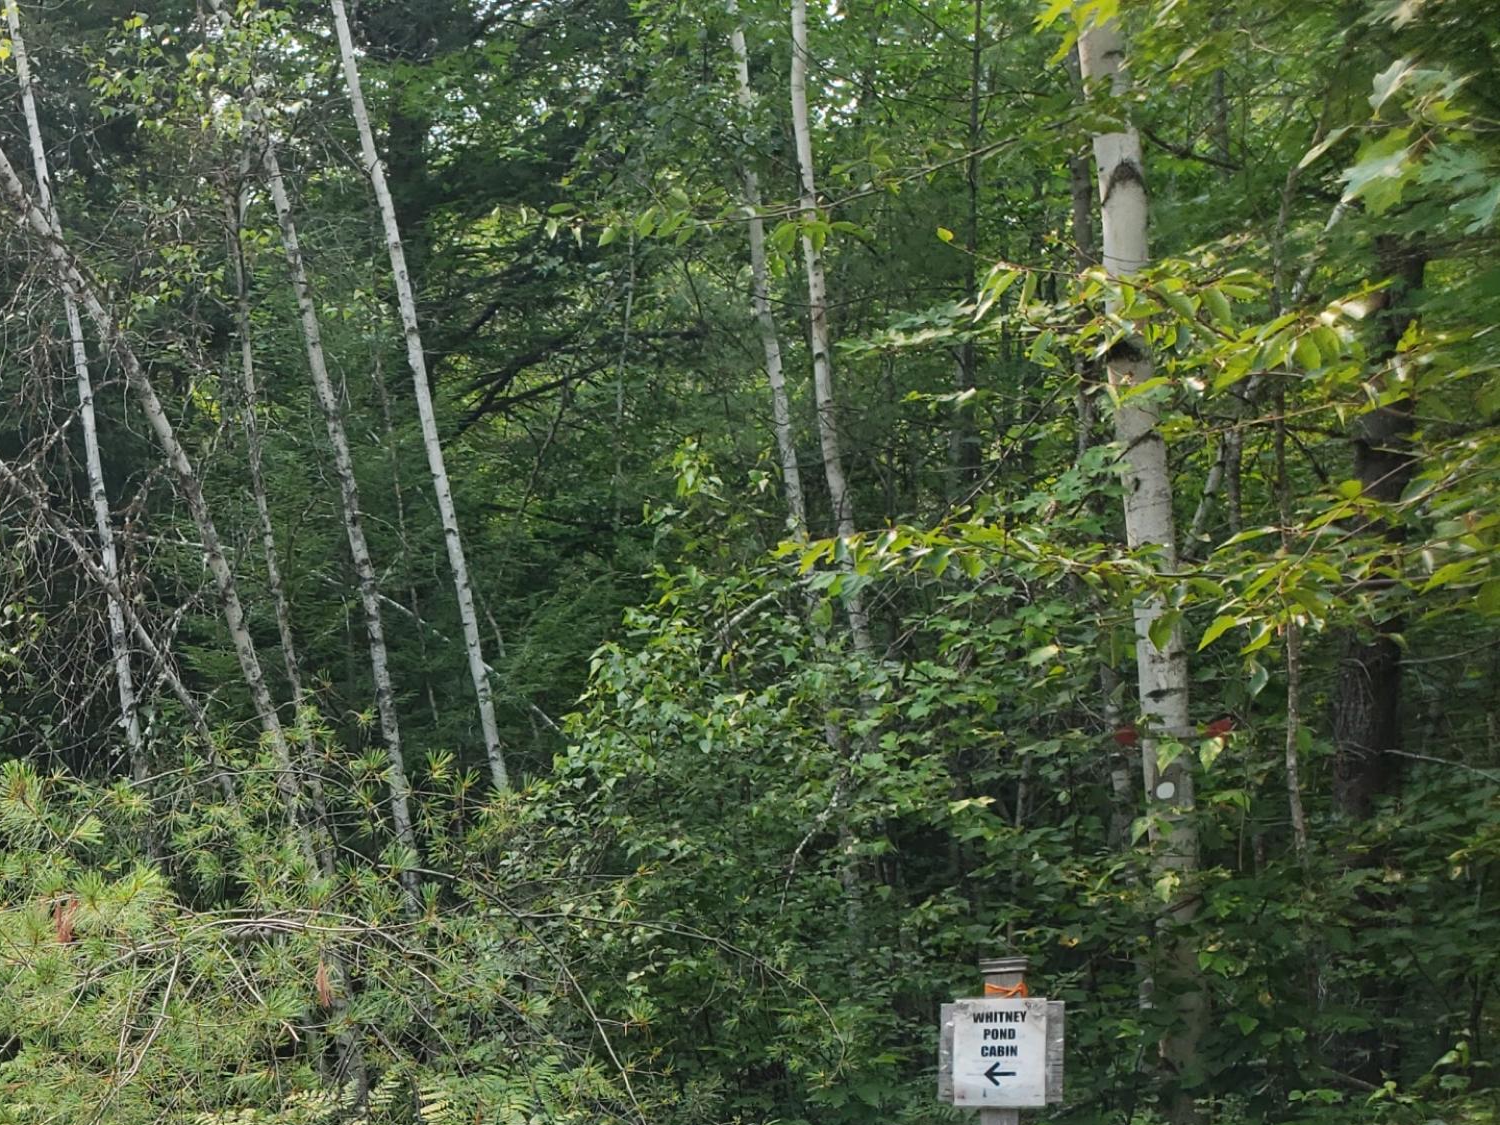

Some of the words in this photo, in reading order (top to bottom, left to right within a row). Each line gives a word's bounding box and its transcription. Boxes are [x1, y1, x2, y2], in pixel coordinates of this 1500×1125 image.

[972, 1011, 1027, 1023] WHITNEY
[983, 1028, 1016, 1040] POND
[980, 1045, 1018, 1057] CABIN
